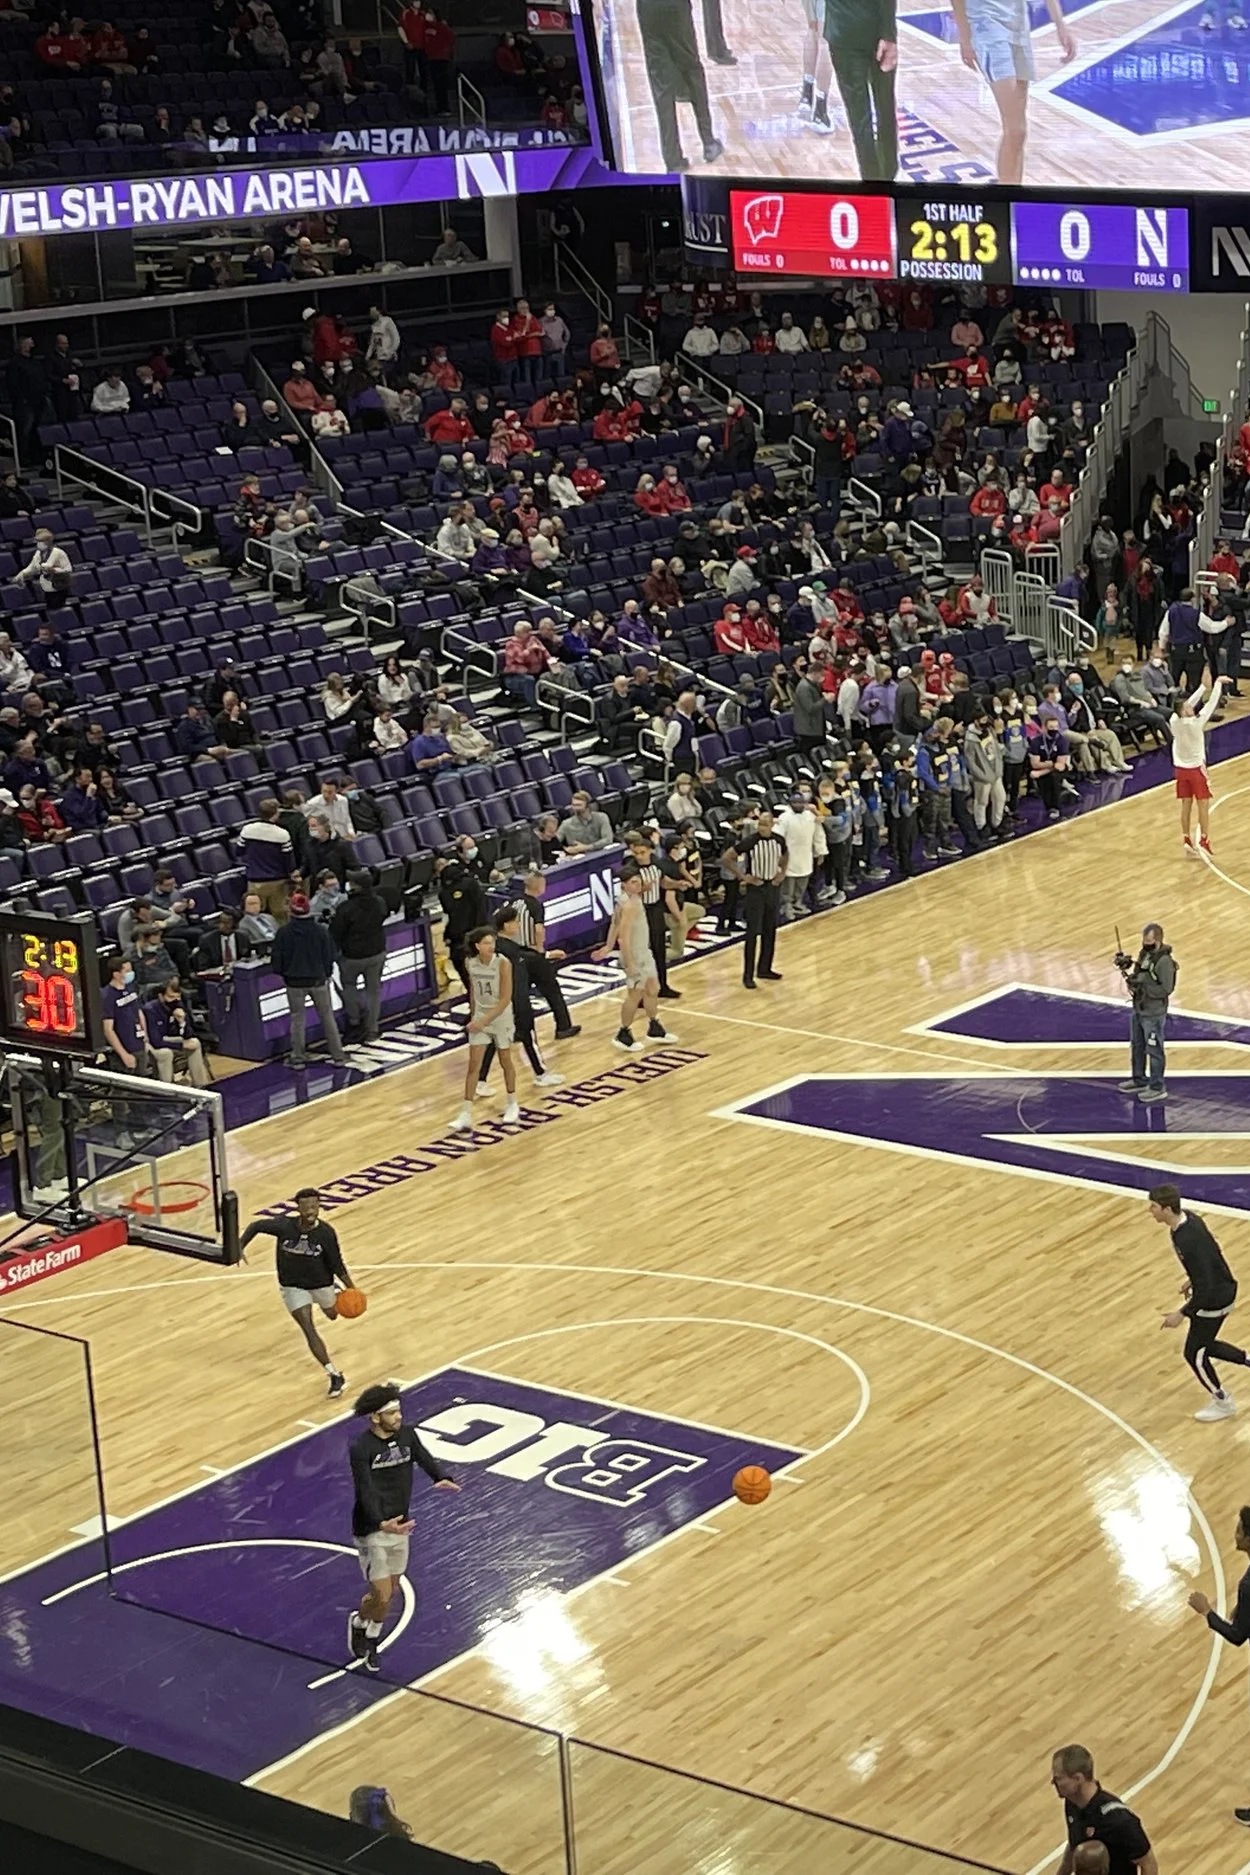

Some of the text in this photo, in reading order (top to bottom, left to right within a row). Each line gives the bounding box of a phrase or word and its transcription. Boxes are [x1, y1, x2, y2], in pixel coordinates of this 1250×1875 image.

[242, 166, 370, 212] ARENA
[455, 150, 518, 199] N
[830, 201, 859, 250] 0
[924, 203, 984, 223] 1ST HALF
[909, 219, 999, 265] 2:13
[1060, 209, 1091, 261] 0
[1136, 207, 1168, 267] N
[743, 253, 785, 268] FOULS 0
[830, 256, 848, 271] TOL
[900, 259, 984, 281] POSSESSION
[1066, 268, 1086, 283] TOL
[1134, 271, 1181, 288] FOULS 0
[23, 933, 78, 974] 2:13
[22, 969, 77, 1034] 30
[477, 980, 493, 997] 14
